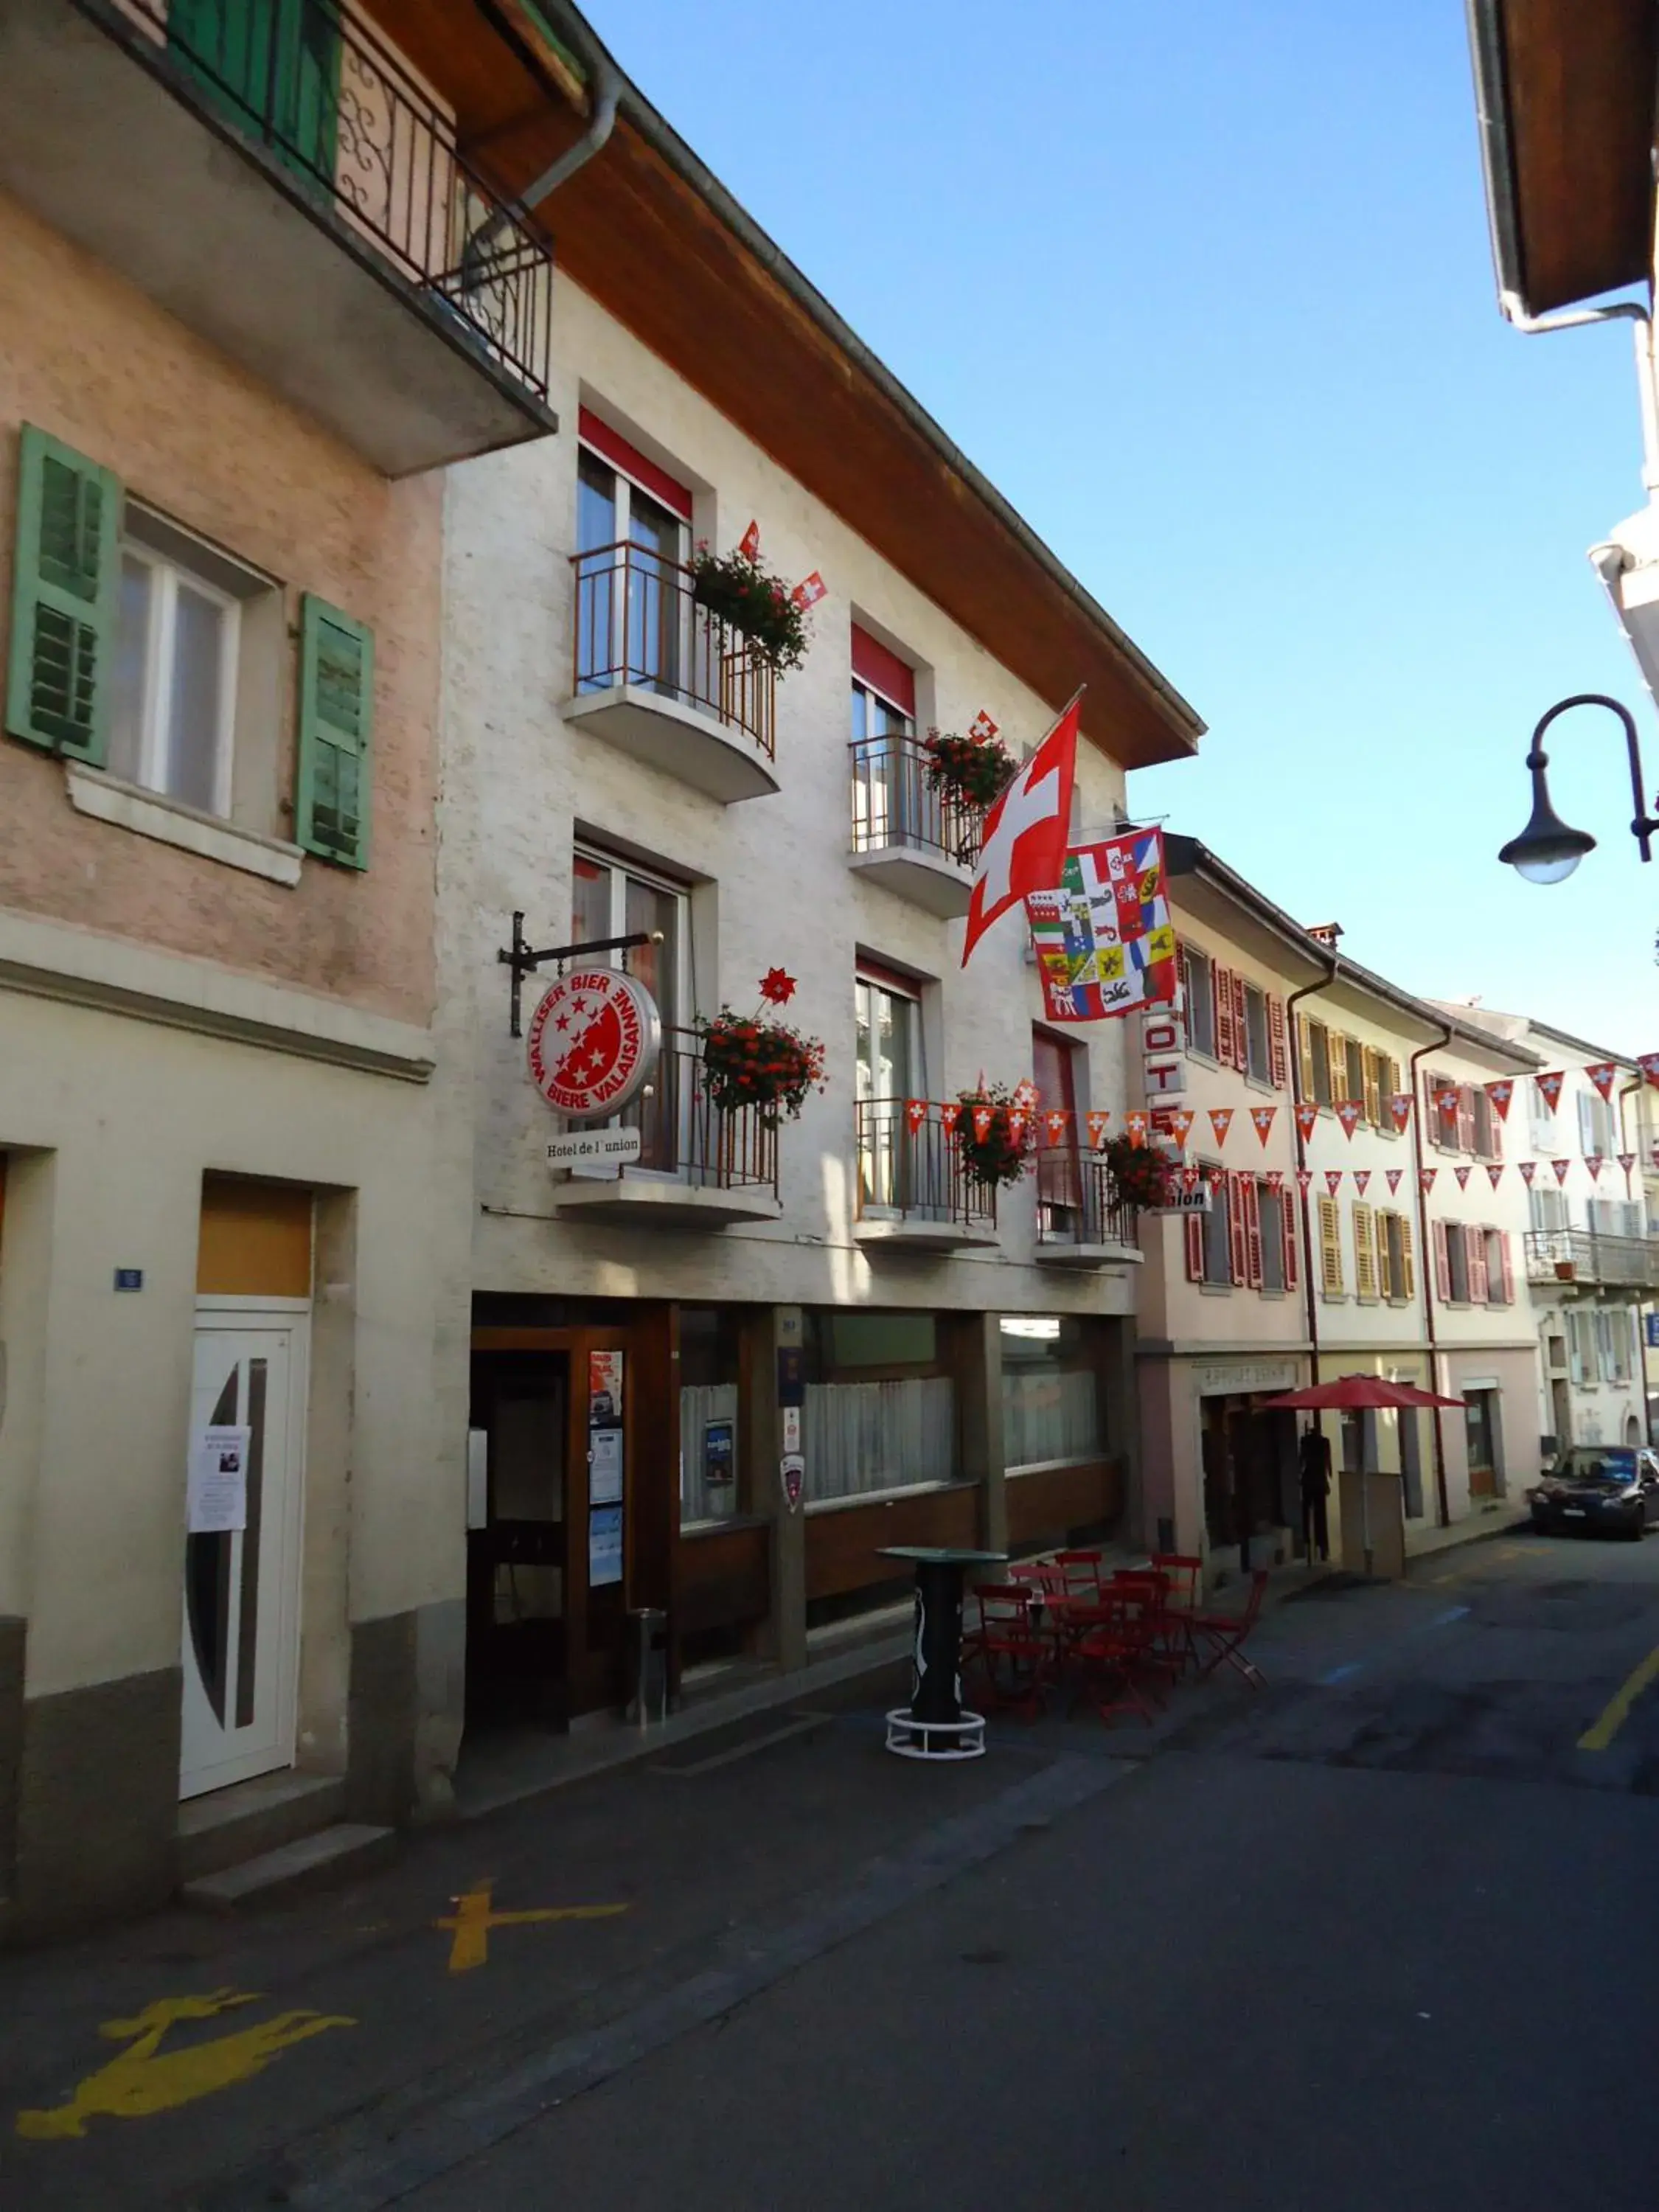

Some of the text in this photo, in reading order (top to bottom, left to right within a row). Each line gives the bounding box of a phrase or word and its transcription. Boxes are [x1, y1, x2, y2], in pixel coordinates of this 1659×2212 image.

[530, 973, 611, 1085] WALLISER BIER
[591, 987, 639, 1102] VALAISANNE
[547, 1143, 577, 1158] Hotel
[579, 1142, 593, 1155] de
